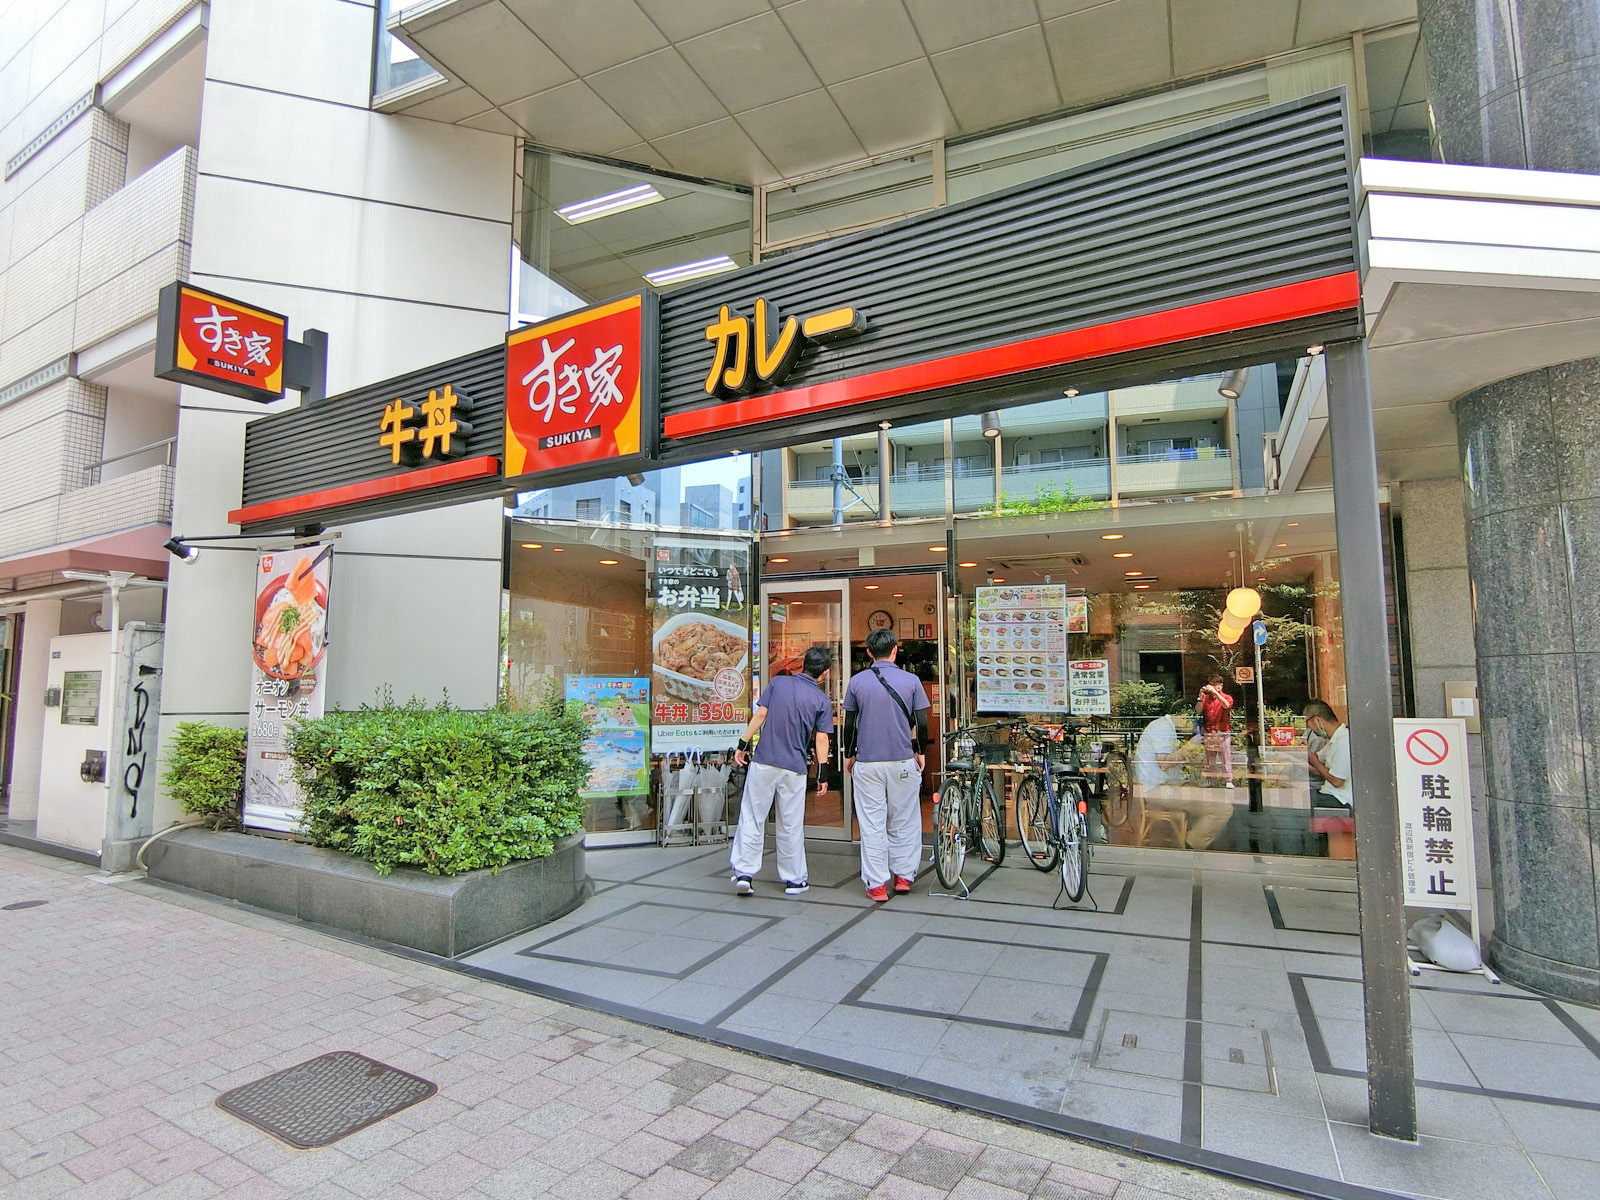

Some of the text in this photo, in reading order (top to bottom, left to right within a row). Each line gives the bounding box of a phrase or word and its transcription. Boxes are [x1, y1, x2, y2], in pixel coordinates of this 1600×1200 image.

[192, 304, 272, 367] すき家
[704, 297, 855, 395] カレー
[214, 360, 250, 375] SUKIYA
[521, 337, 624, 424] すき家
[378, 384, 459, 465] 牛丼
[546, 429, 593, 448] SUKIYA
[658, 567, 719, 577] いつでもどこでも
[657, 585, 720, 609] お弁当
[1072, 671, 1104, 679] 通常営業
[255, 678, 289, 697] オニオン
[254, 697, 310, 721] サーモン丼
[655, 703, 688, 722] 牛丼
[699, 702, 745, 721] 350円
[1421, 774, 1457, 896] 駐輪禁止
